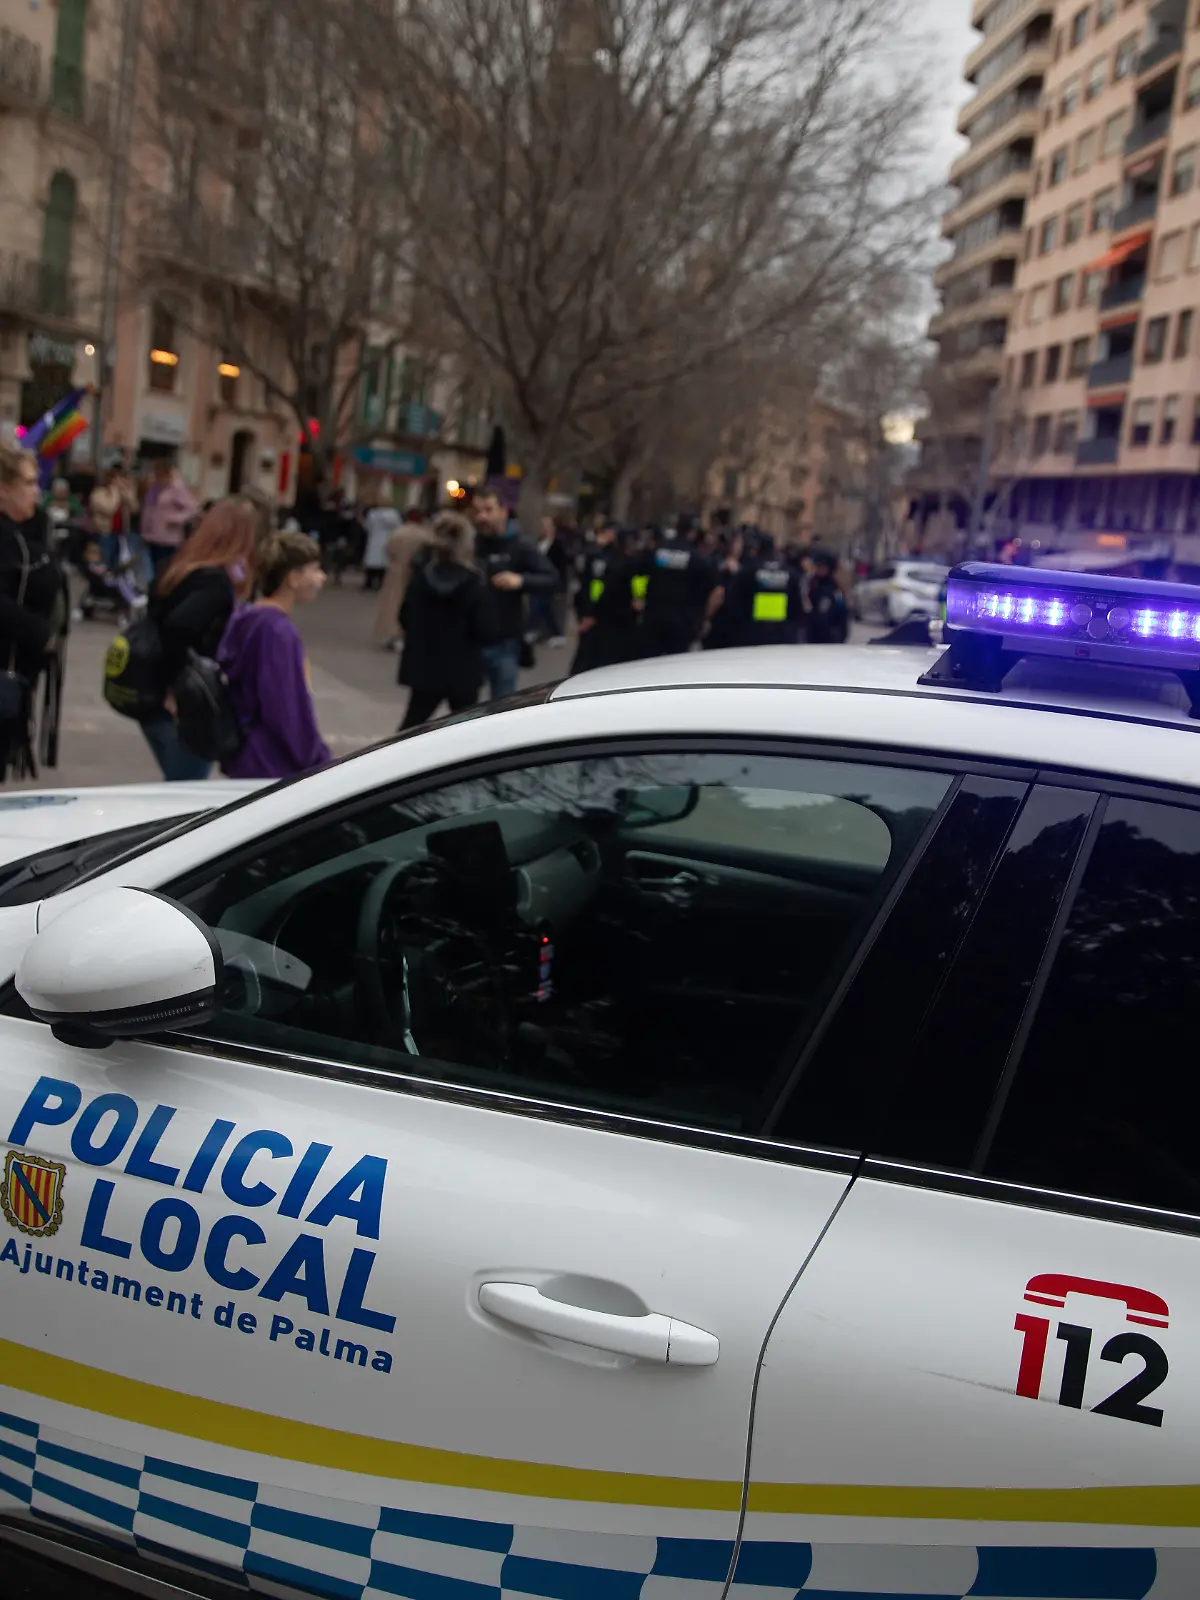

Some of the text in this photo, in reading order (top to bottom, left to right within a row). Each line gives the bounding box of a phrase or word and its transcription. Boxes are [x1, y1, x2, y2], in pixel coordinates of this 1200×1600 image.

[7, 1076, 388, 1240] POLICIA
[0, 1238, 393, 1373] Ajuntament de Palma
[80, 1178, 397, 1333] LOCAL
[1014, 1313, 1168, 1427] 112
